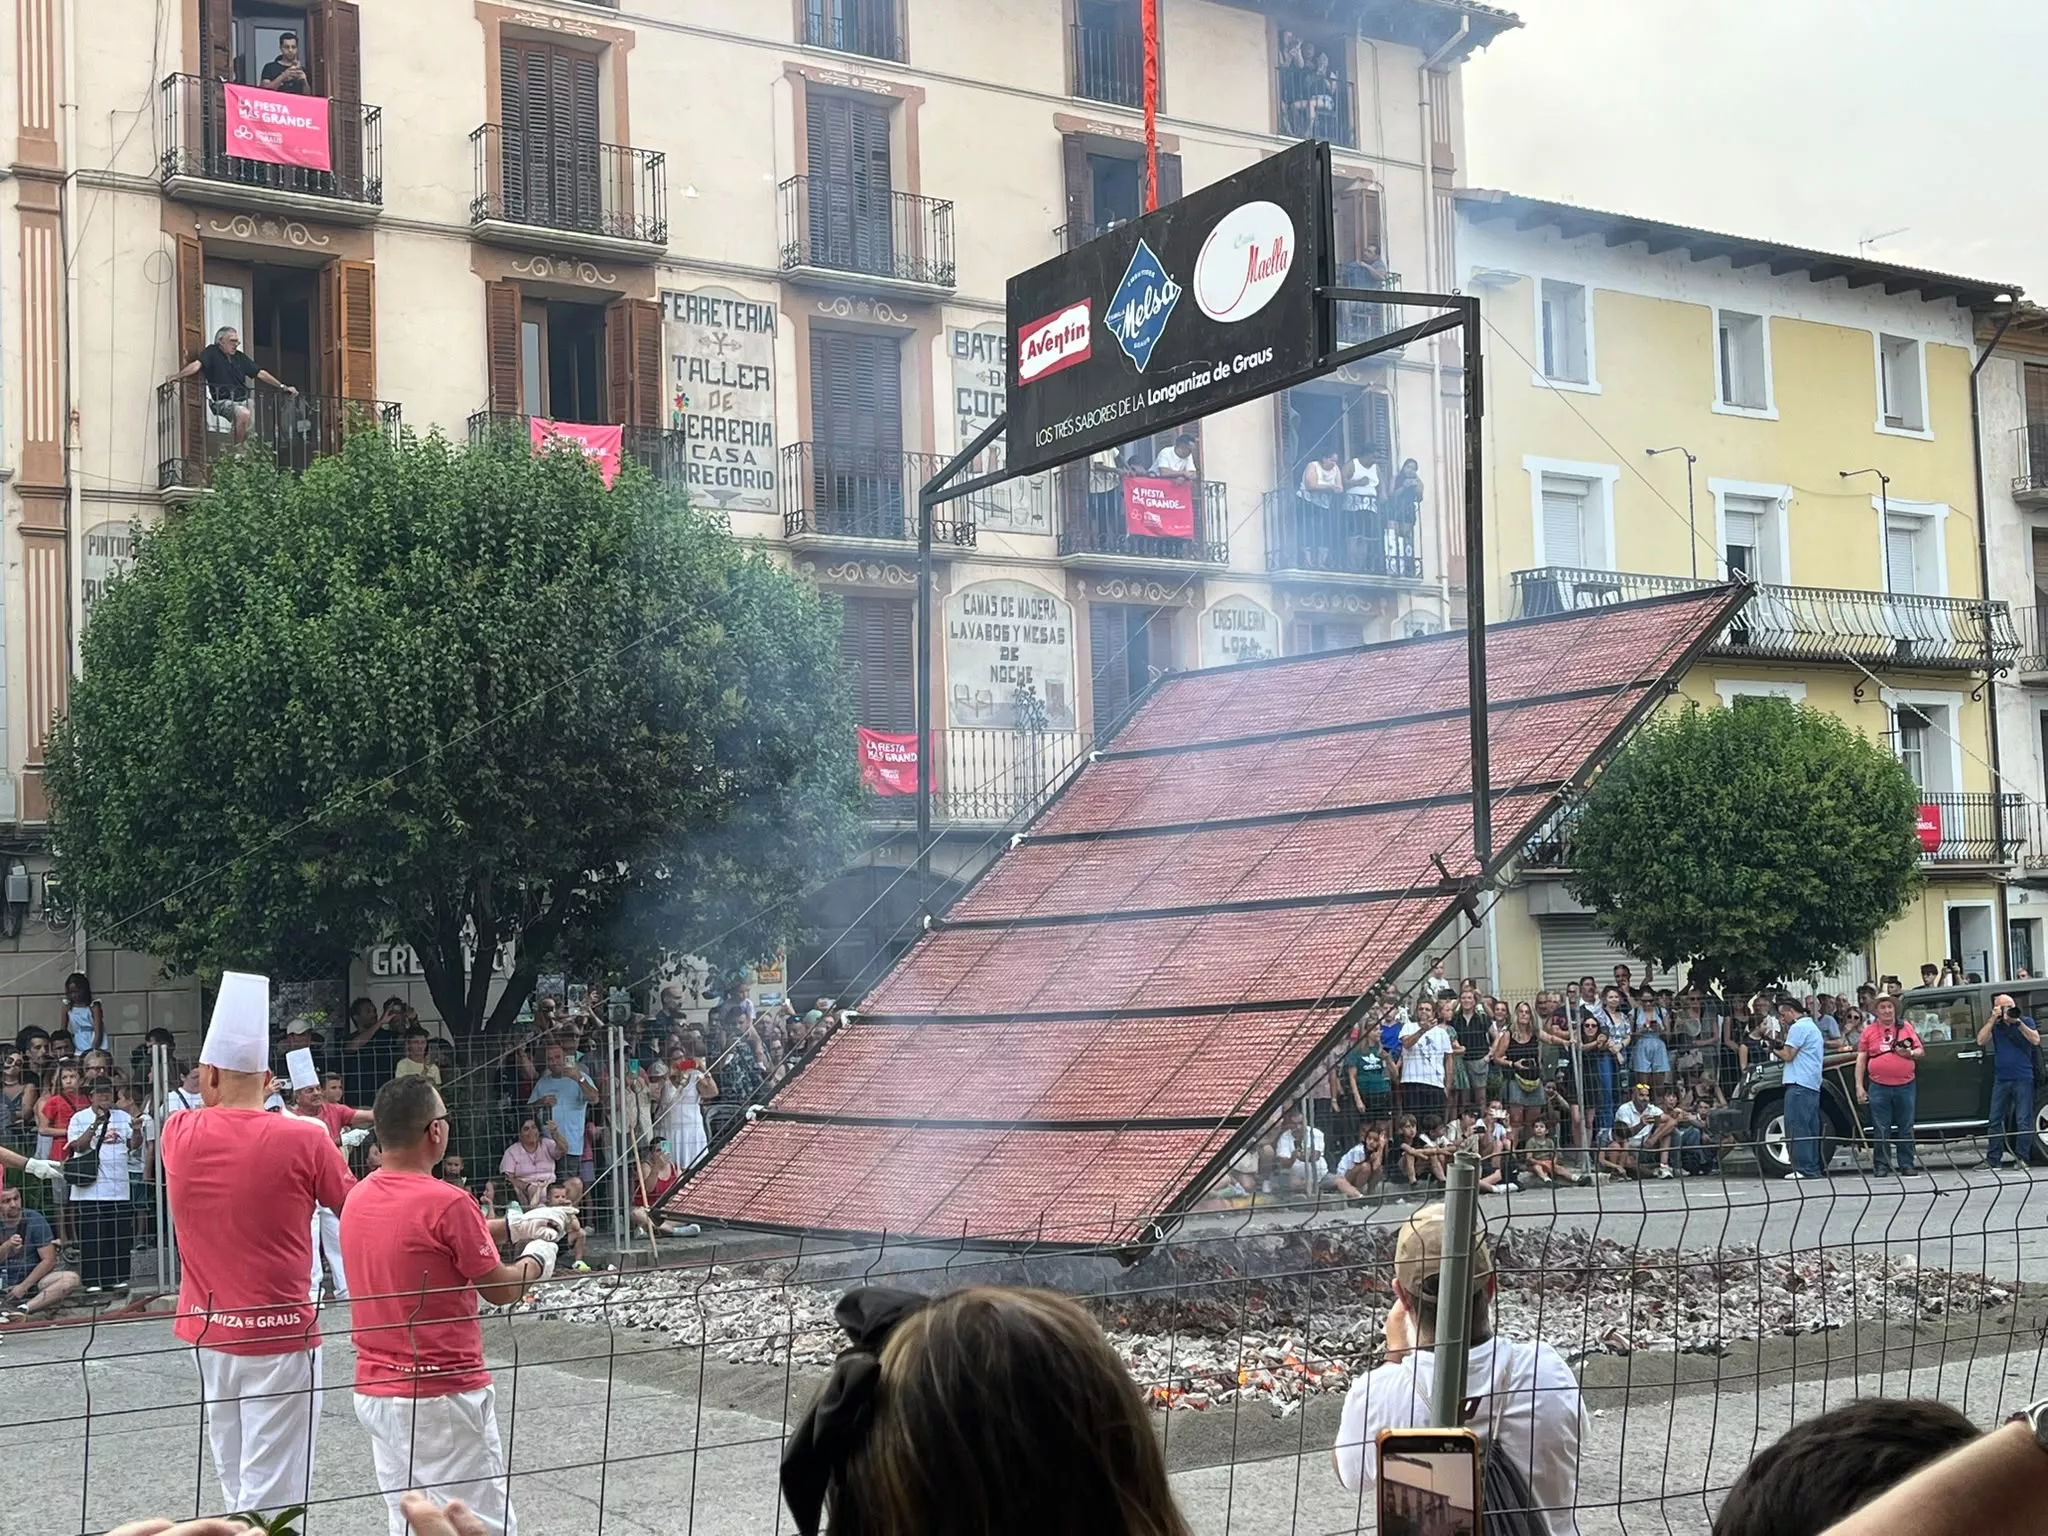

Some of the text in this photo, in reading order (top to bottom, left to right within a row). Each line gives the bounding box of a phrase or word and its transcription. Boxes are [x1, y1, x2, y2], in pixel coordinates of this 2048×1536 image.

[253, 100, 290, 114] FIESTA
[1247, 235, 1288, 284] Maella
[660, 290, 776, 335] FERRETERIA
[1117, 280, 1177, 341] Melsa
[711, 331, 729, 357] Y
[954, 329, 1006, 365] BATE
[1027, 322, 1086, 360] Aventín
[671, 354, 771, 392] TALLER
[708, 389, 734, 412] DE
[956, 387, 1006, 419] COC
[1035, 346, 1274, 448] LOS TRES SABORES DE LA Longaniza de Graus
[691, 444, 758, 466] CASA
[677, 462, 775, 491] REGORIO
[1140, 487, 1165, 499] FIESTA
[963, 593, 1058, 621] CAMAS DE MADERA
[950, 621, 1066, 646] LAVABOS Y MESAS
[1000, 646, 1020, 661] DE
[990, 665, 1034, 685] NOCHE
[866, 739, 906, 753] LA FIESTA
[884, 752, 918, 763] GRAND
[256, 1312, 302, 1328] GRAUS
